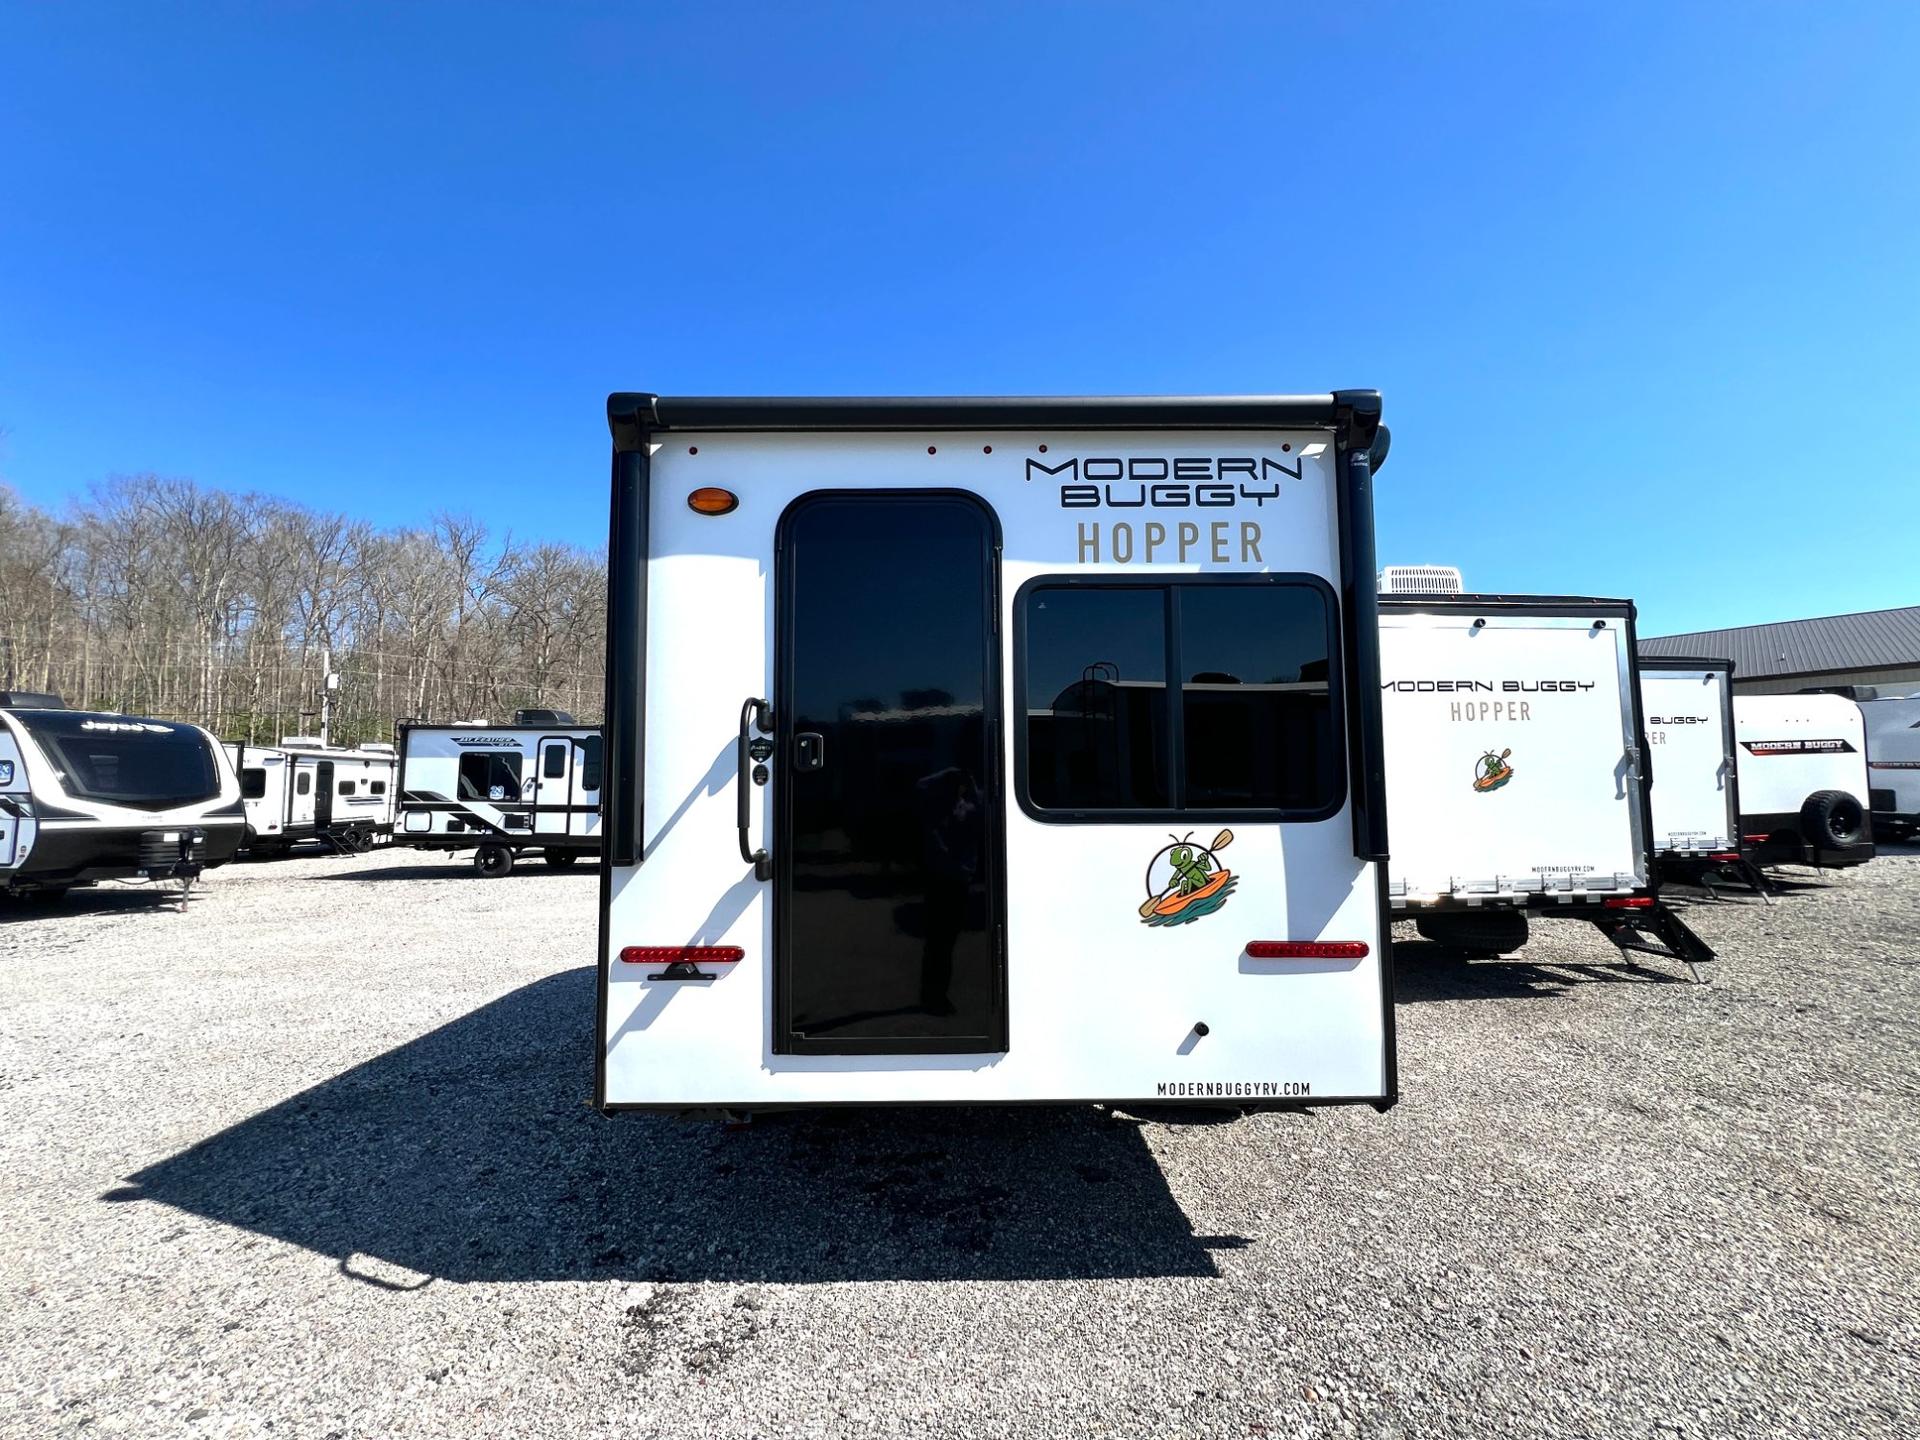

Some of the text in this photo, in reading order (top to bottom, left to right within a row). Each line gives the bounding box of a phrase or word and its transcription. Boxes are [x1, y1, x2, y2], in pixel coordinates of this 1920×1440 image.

[1026, 457, 1302, 481] MODERN
[1061, 484, 1279, 508] BUGGY
[1078, 522, 1262, 564] HOPPER
[1502, 681, 1595, 692] BUGGY
[1450, 701, 1531, 721] HOPPER
[1650, 716, 1708, 724] BUGGY
[1751, 740, 1843, 750] MODERN BUGGY
[1157, 1083, 1311, 1096] MODERNBUGGYRV.COM
